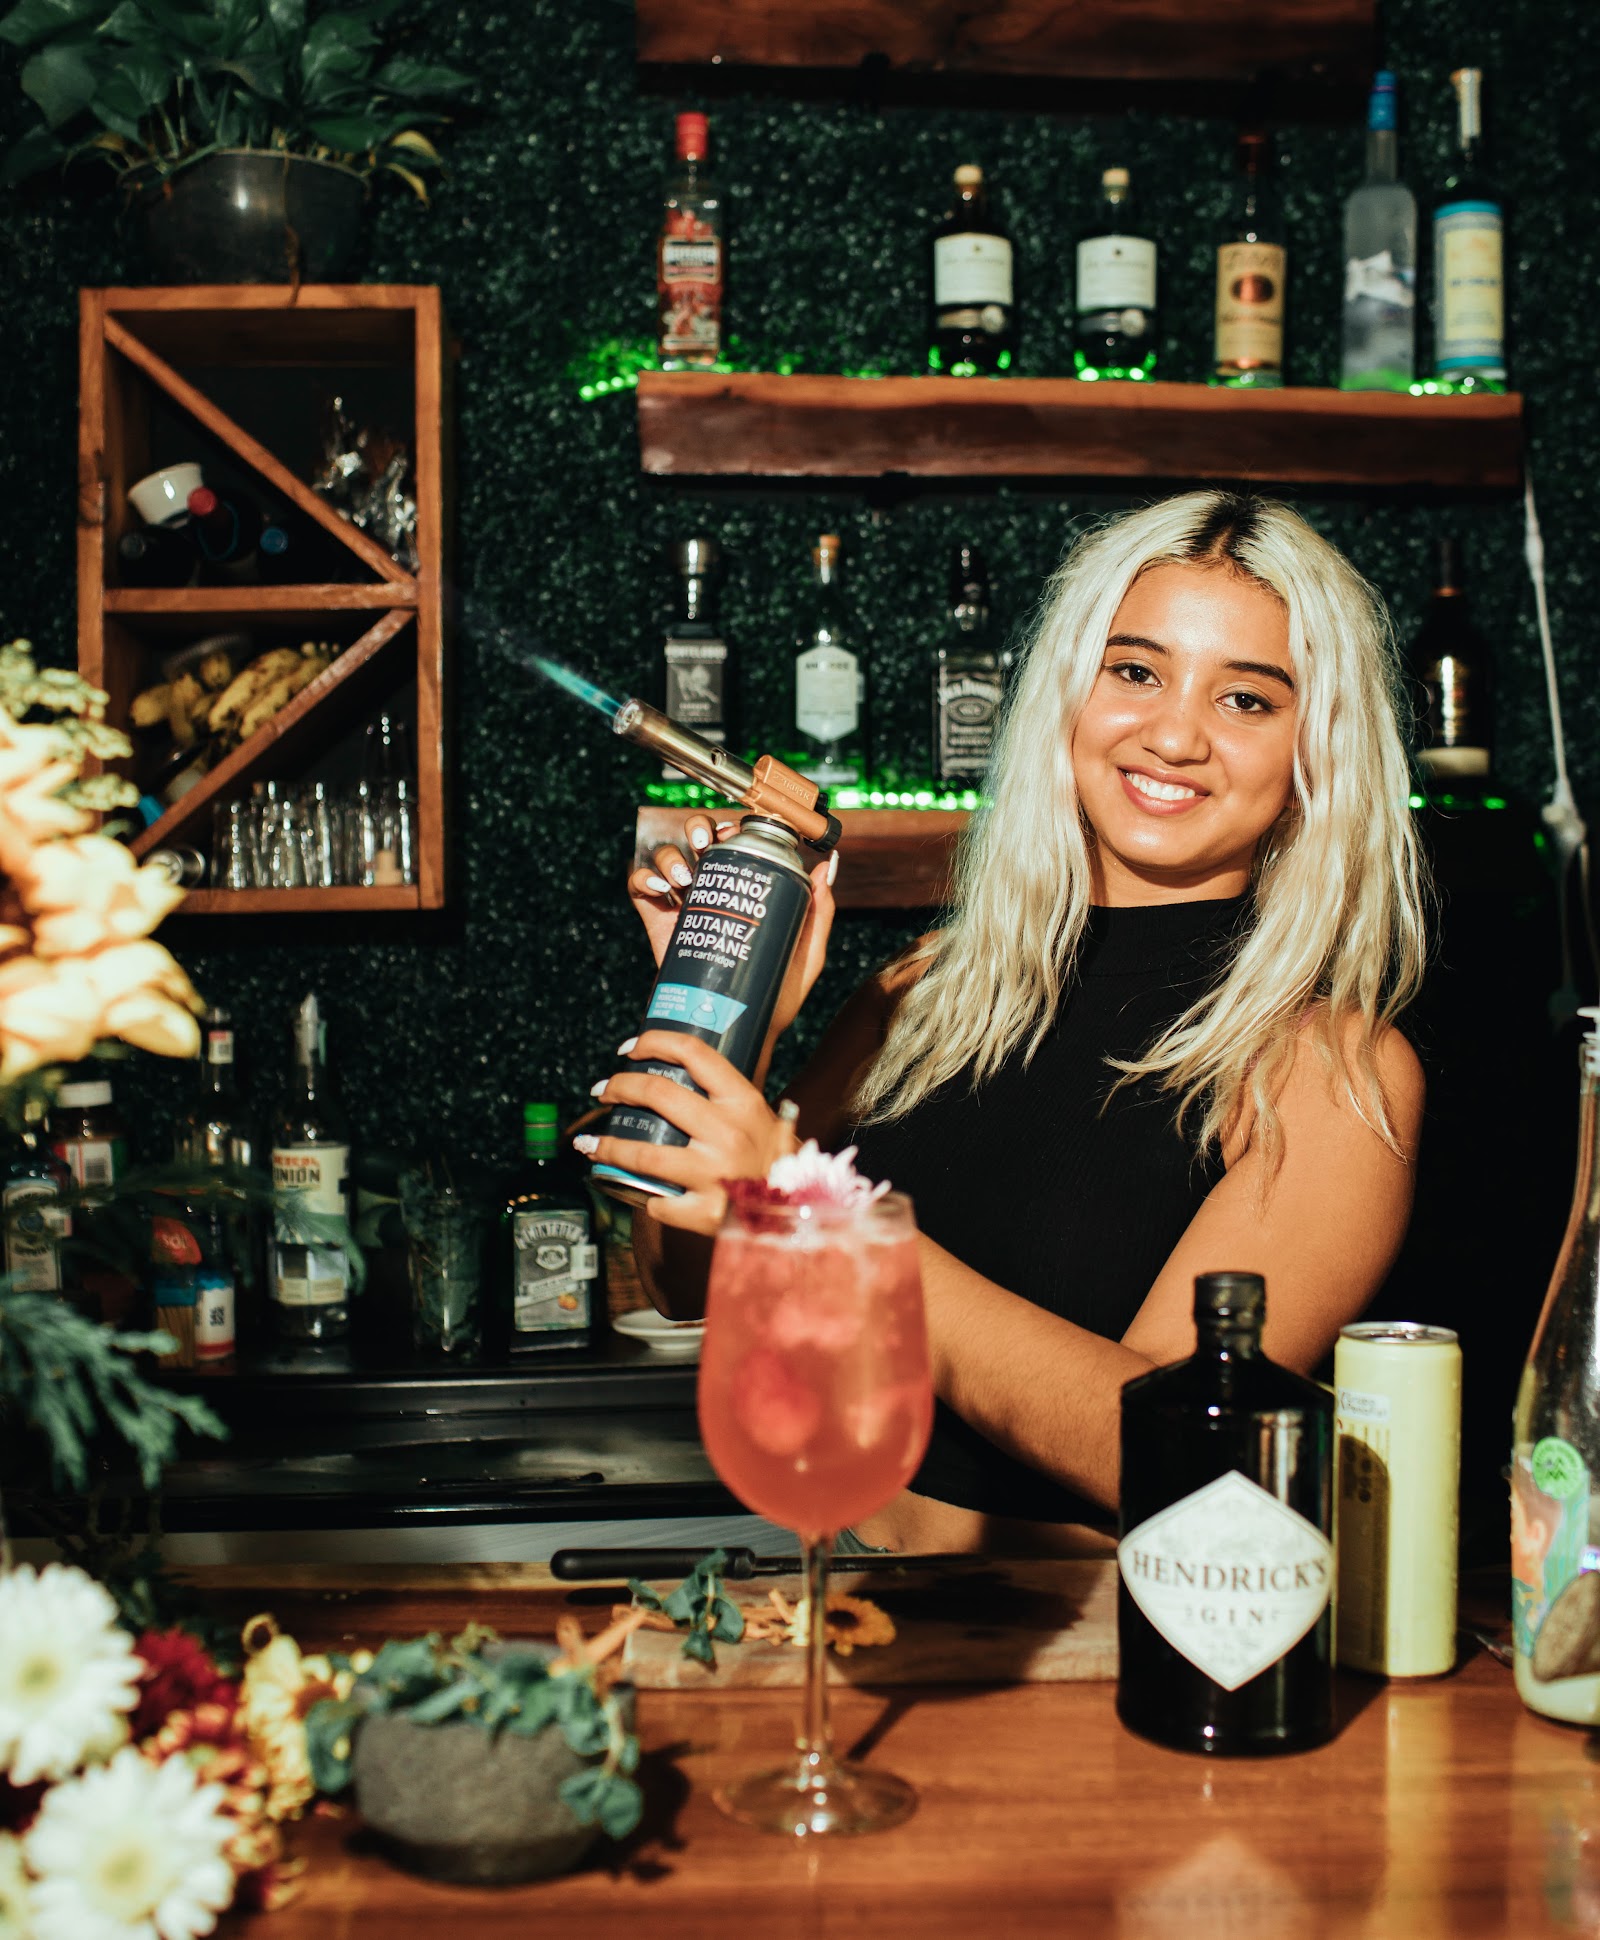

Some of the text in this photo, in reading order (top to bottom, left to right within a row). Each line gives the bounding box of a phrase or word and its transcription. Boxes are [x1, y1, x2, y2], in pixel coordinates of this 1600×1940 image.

[696, 873, 772, 901] BUTANO/
[702, 862, 772, 884] Cartucho de gas
[688, 890, 767, 918] PROPANO
[683, 915, 756, 943] BUTANE/
[676, 931, 751, 960] PROPANE
[678, 949, 736, 968] gas cartridge
[1201, 1608, 1264, 1625] GIN
